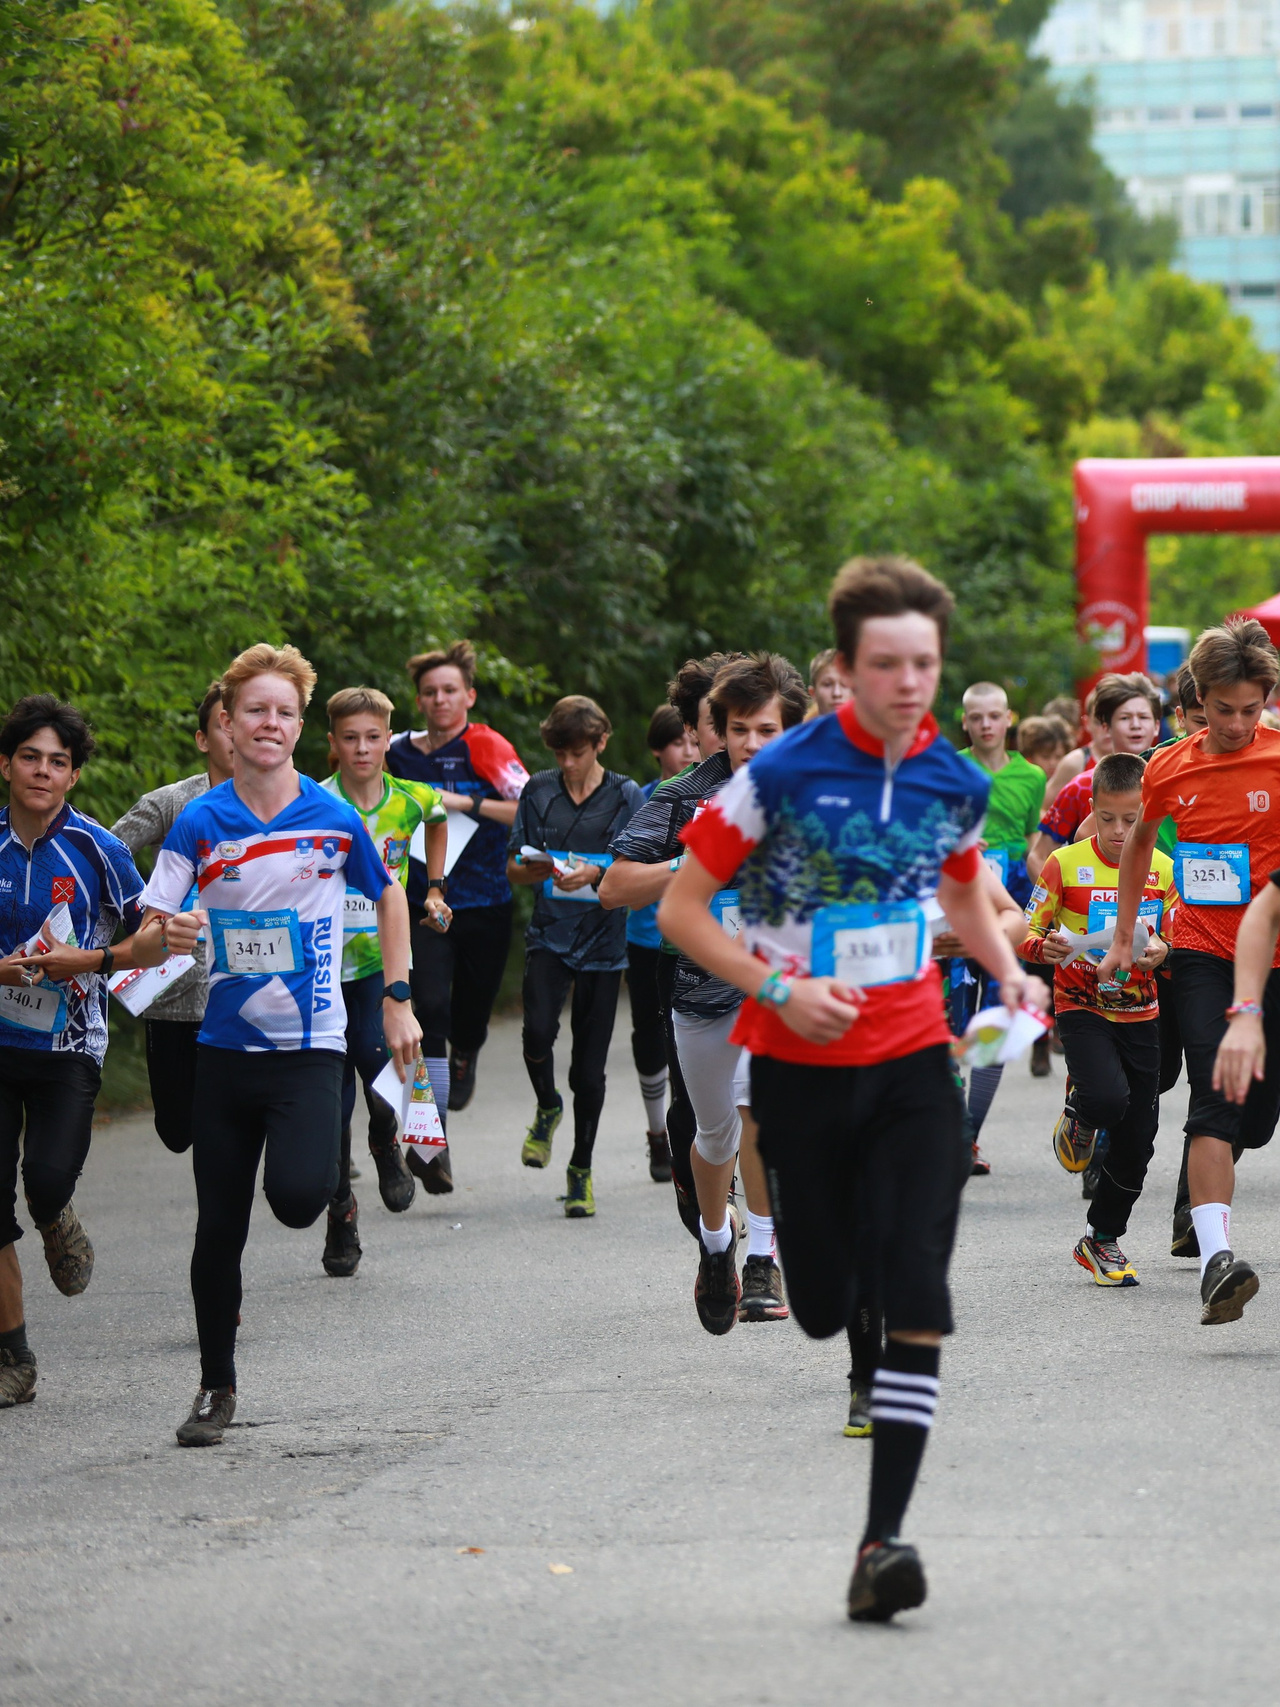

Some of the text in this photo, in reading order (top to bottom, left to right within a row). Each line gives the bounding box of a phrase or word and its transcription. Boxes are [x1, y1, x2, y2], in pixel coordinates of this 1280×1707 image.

[1246, 790, 1270, 813] 10
[1192, 869, 1226, 882] 325.1
[343, 900, 375, 912] 320.1
[235, 941, 276, 956] 347.1
[312, 915, 333, 1015] RUSSIA
[4, 988, 43, 1010] 340.1
[408, 1122, 428, 1130] 347.1
